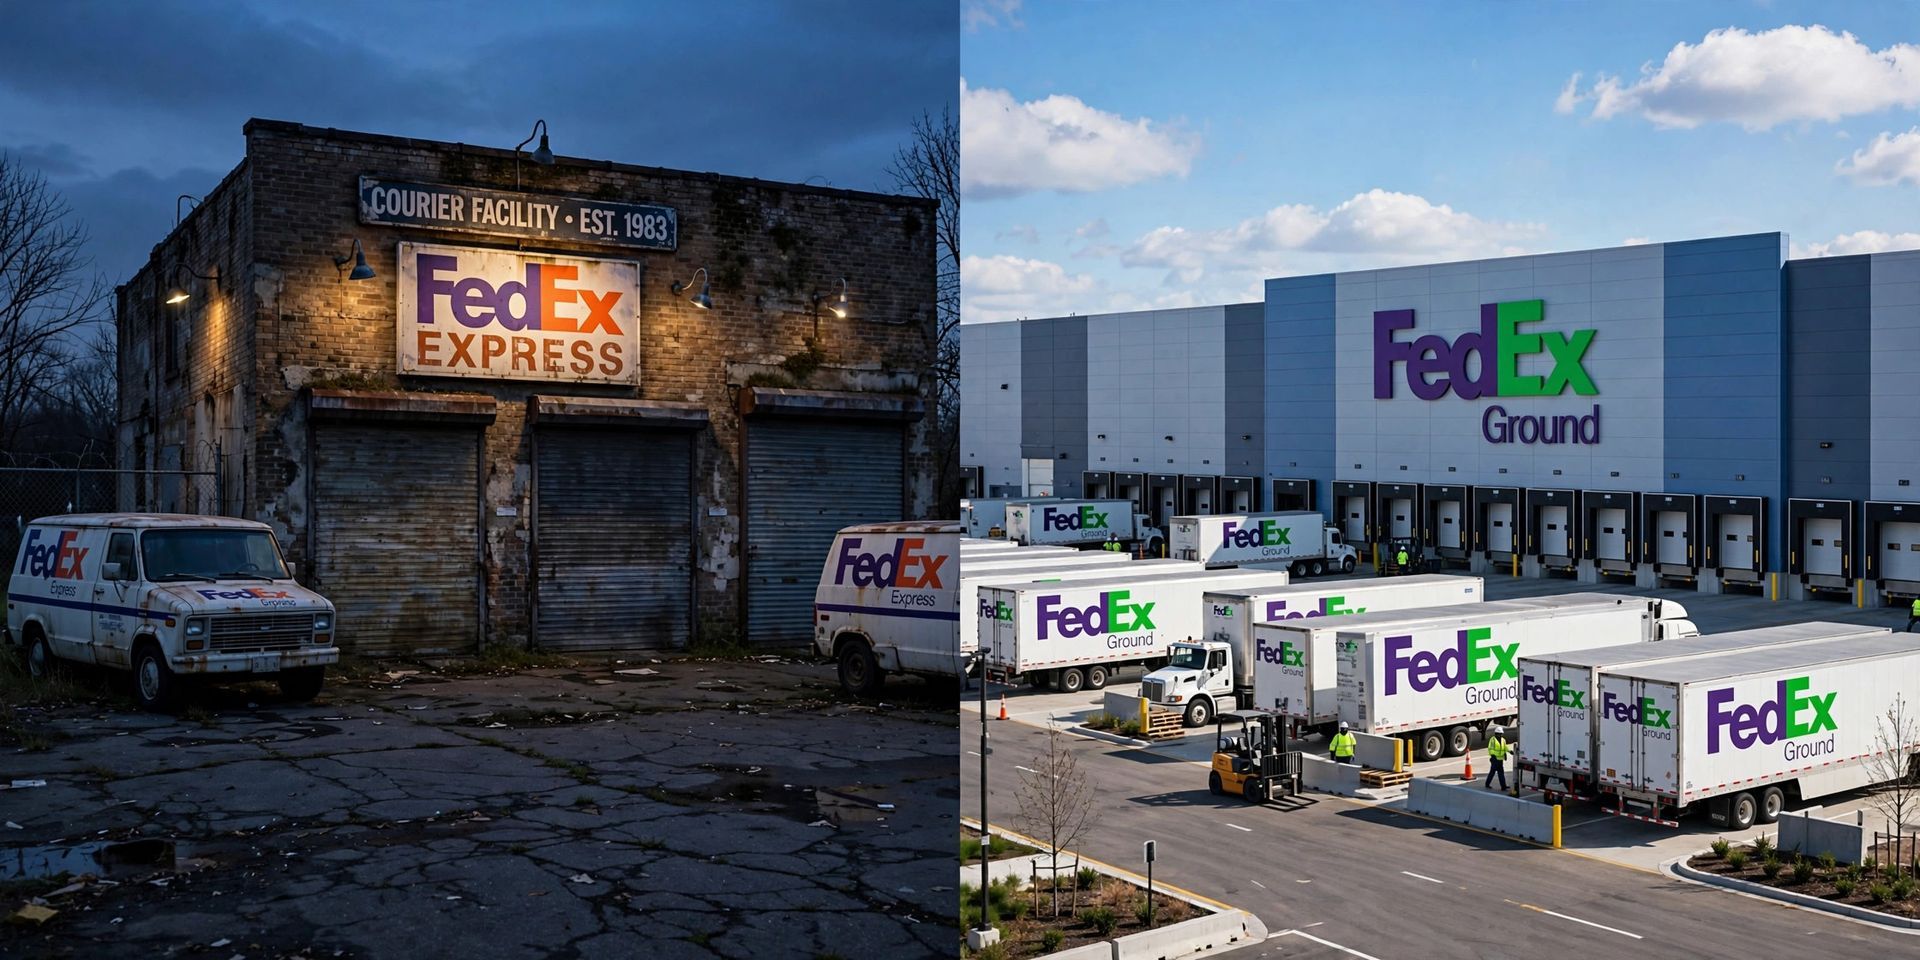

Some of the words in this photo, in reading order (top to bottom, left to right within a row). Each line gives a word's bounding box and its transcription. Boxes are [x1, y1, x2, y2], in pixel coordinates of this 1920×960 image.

[371, 186, 464, 221] COURIER
[472, 197, 559, 230] FACILITY
[580, 208, 618, 236] EST.
[624, 212, 668, 241] 1983
[416, 253, 624, 336] FedEx
[417, 330, 623, 376] EXPRESS
[1373, 299, 1600, 401] FedEx
[1482, 403, 1600, 445] Ground
[1043, 505, 1109, 531] FedEx
[1222, 519, 1291, 548] FedEx
[20, 529, 90, 580] FedEx
[834, 538, 949, 589] FedEx
[1261, 545, 1290, 556] Ground
[50, 580, 77, 598] Express
[196, 587, 295, 600] FedEx
[891, 589, 936, 608] Express
[979, 598, 1013, 622] FedEx
[1036, 590, 1156, 640] FedEx
[1213, 604, 1234, 616] FedEx
[1107, 632, 1154, 650] Ground
[1256, 638, 1304, 667] FedEx
[1281, 665, 1304, 677] Ground
[1384, 627, 1520, 696] FedEx
[1465, 681, 1517, 705] Ground
[1522, 674, 1585, 710] FedEx
[1557, 706, 1585, 721] Ground
[1603, 691, 1671, 729] FedEx
[1707, 676, 1838, 755] FedEx
[1642, 726, 1671, 741] Ground
[1784, 733, 1835, 762] Ground
